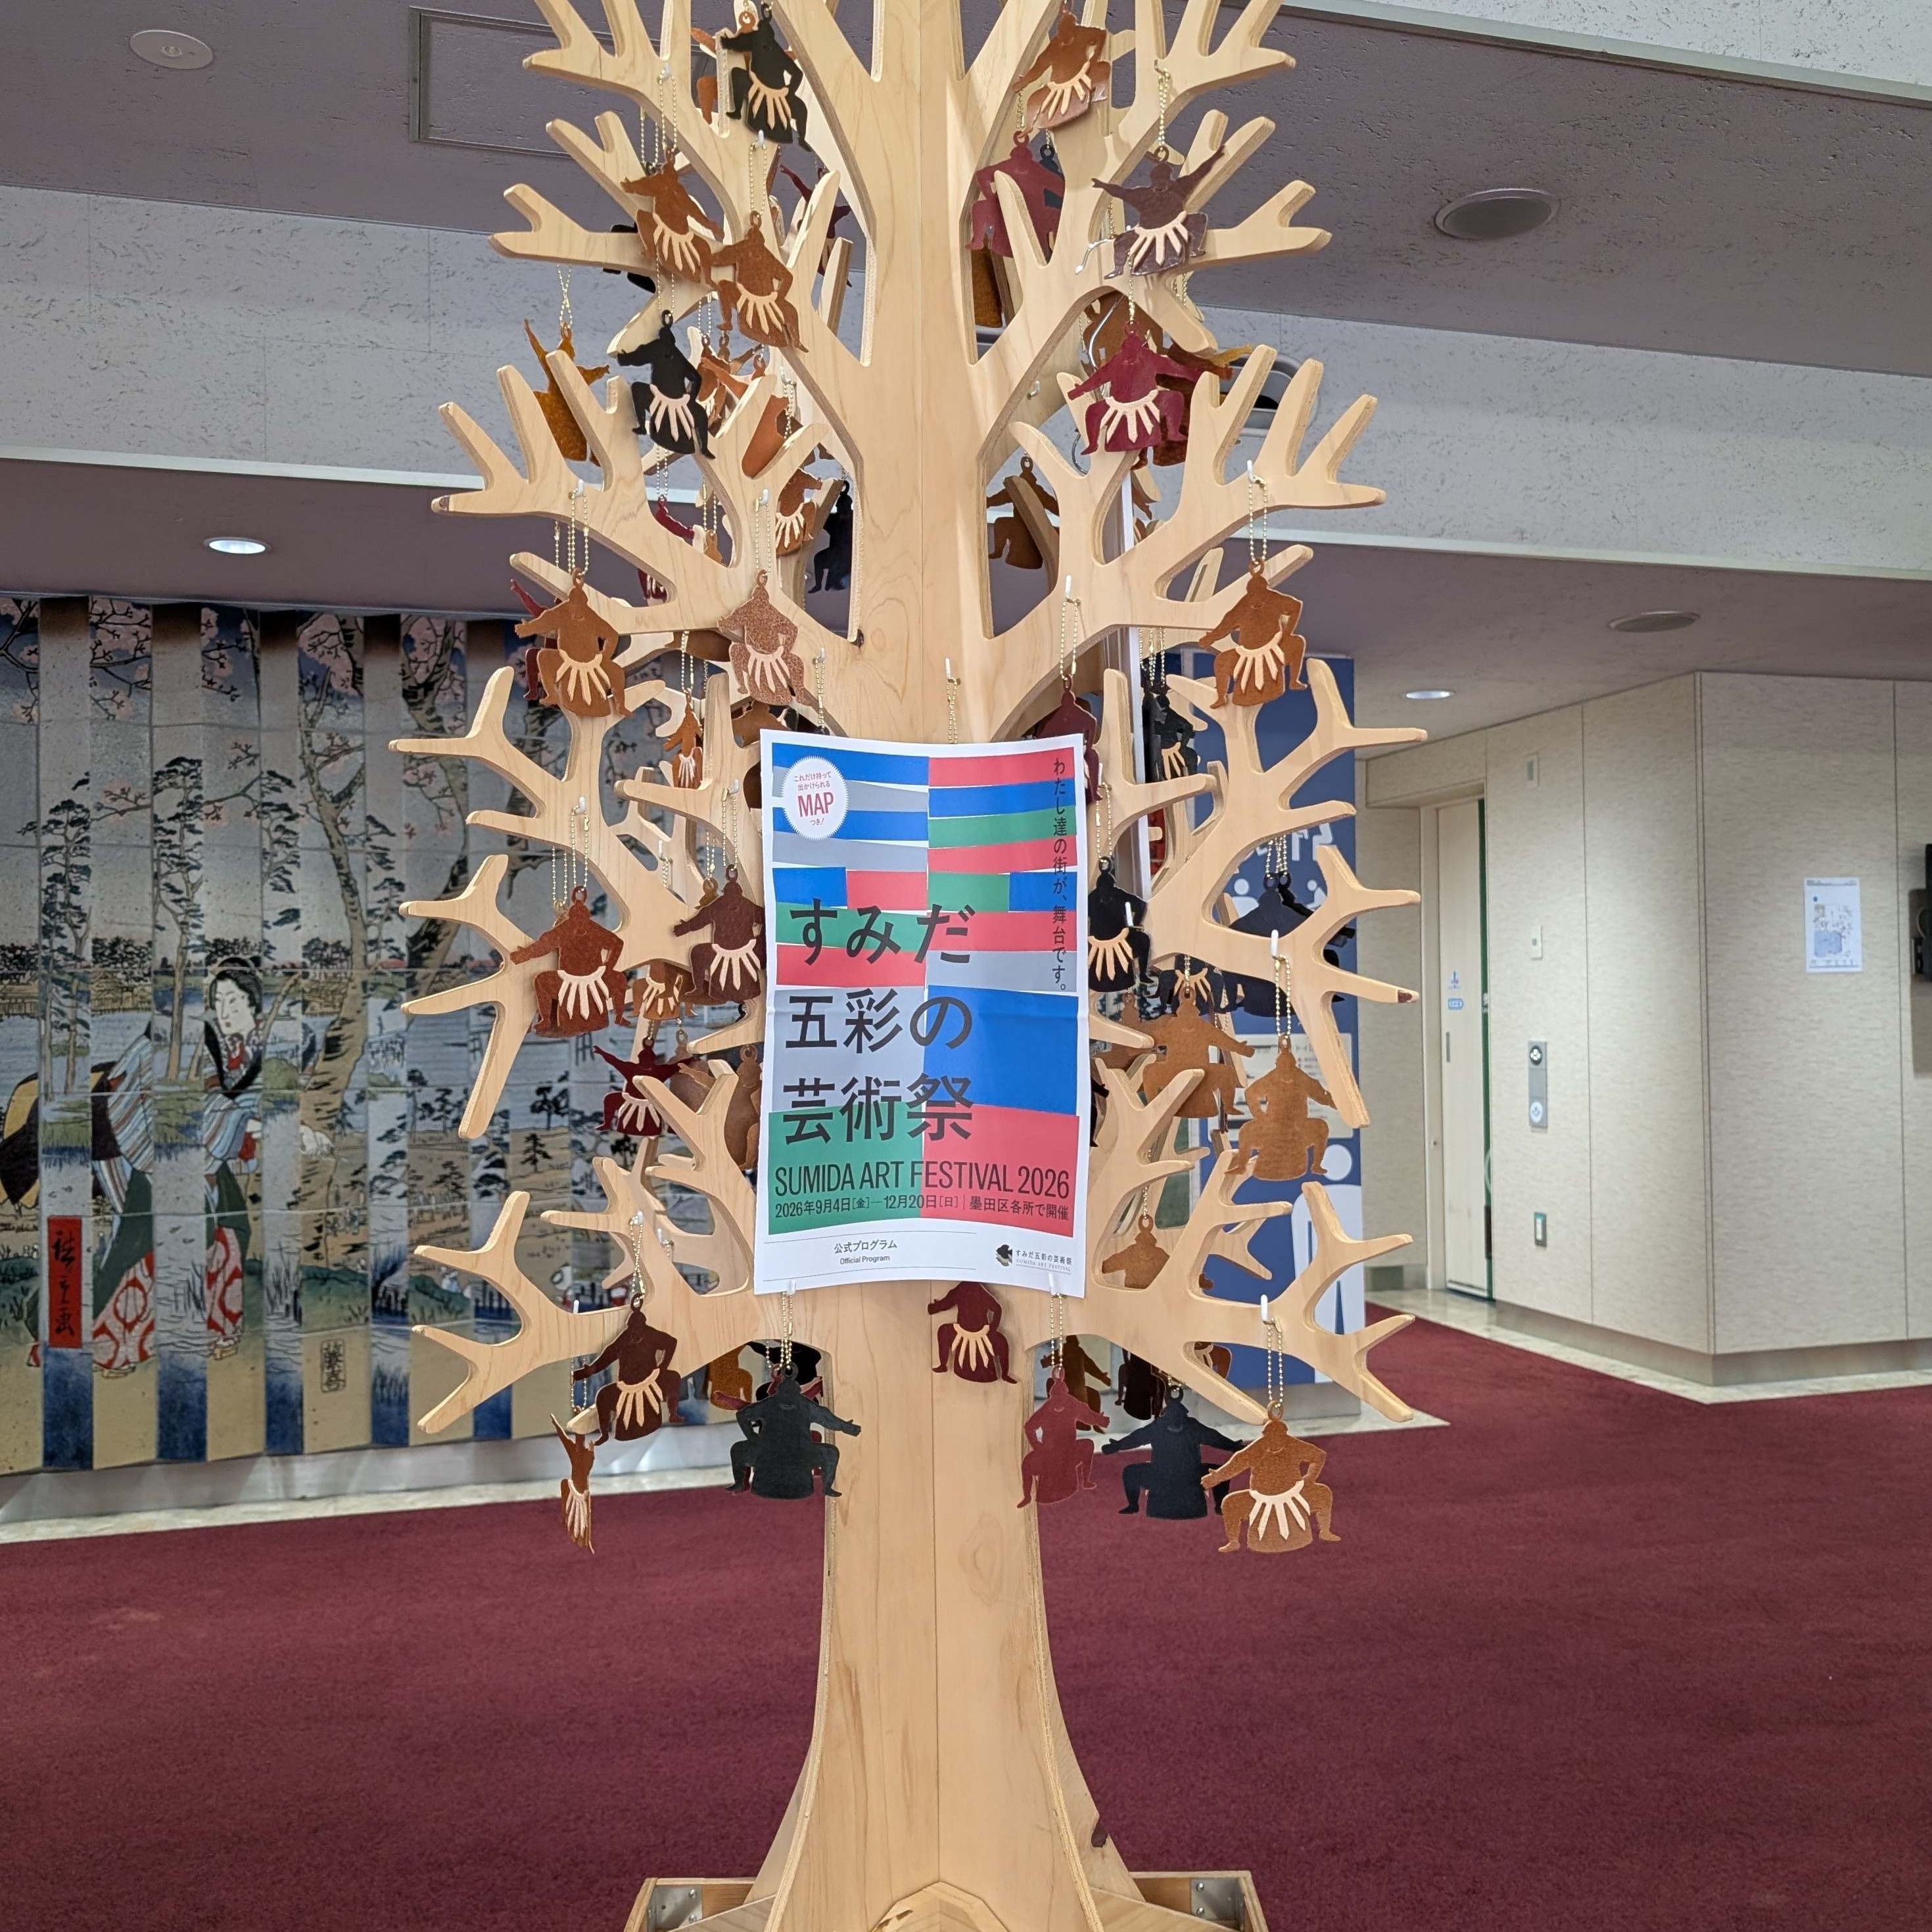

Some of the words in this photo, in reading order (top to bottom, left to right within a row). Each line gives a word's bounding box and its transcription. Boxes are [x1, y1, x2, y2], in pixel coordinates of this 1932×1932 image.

[794, 771, 832, 782] これだけ持って
[798, 780, 831, 791] 出かけられる
[797, 791, 834, 817] MAP
[1051, 758, 1068, 991] わたし達の街が、舞台です。
[789, 898, 976, 966] すみだ
[785, 988, 973, 1054] 五彩の
[783, 1072, 974, 1145] 芸術祭
[775, 1163, 855, 1196] SUMIDA
[859, 1161, 905, 1190] ART
[910, 1160, 1014, 1192] FESTIVAL
[1018, 1166, 1070, 1199] 2026
[969, 1196, 1069, 1221] 墨田区各所で開催
[834, 1239, 897, 1254] 公式プログラム
[1016, 1250, 1072, 1265] すみだ五彩の芸術祭
[839, 1256, 860, 1265] Official
[862, 1255, 890, 1263] Program
